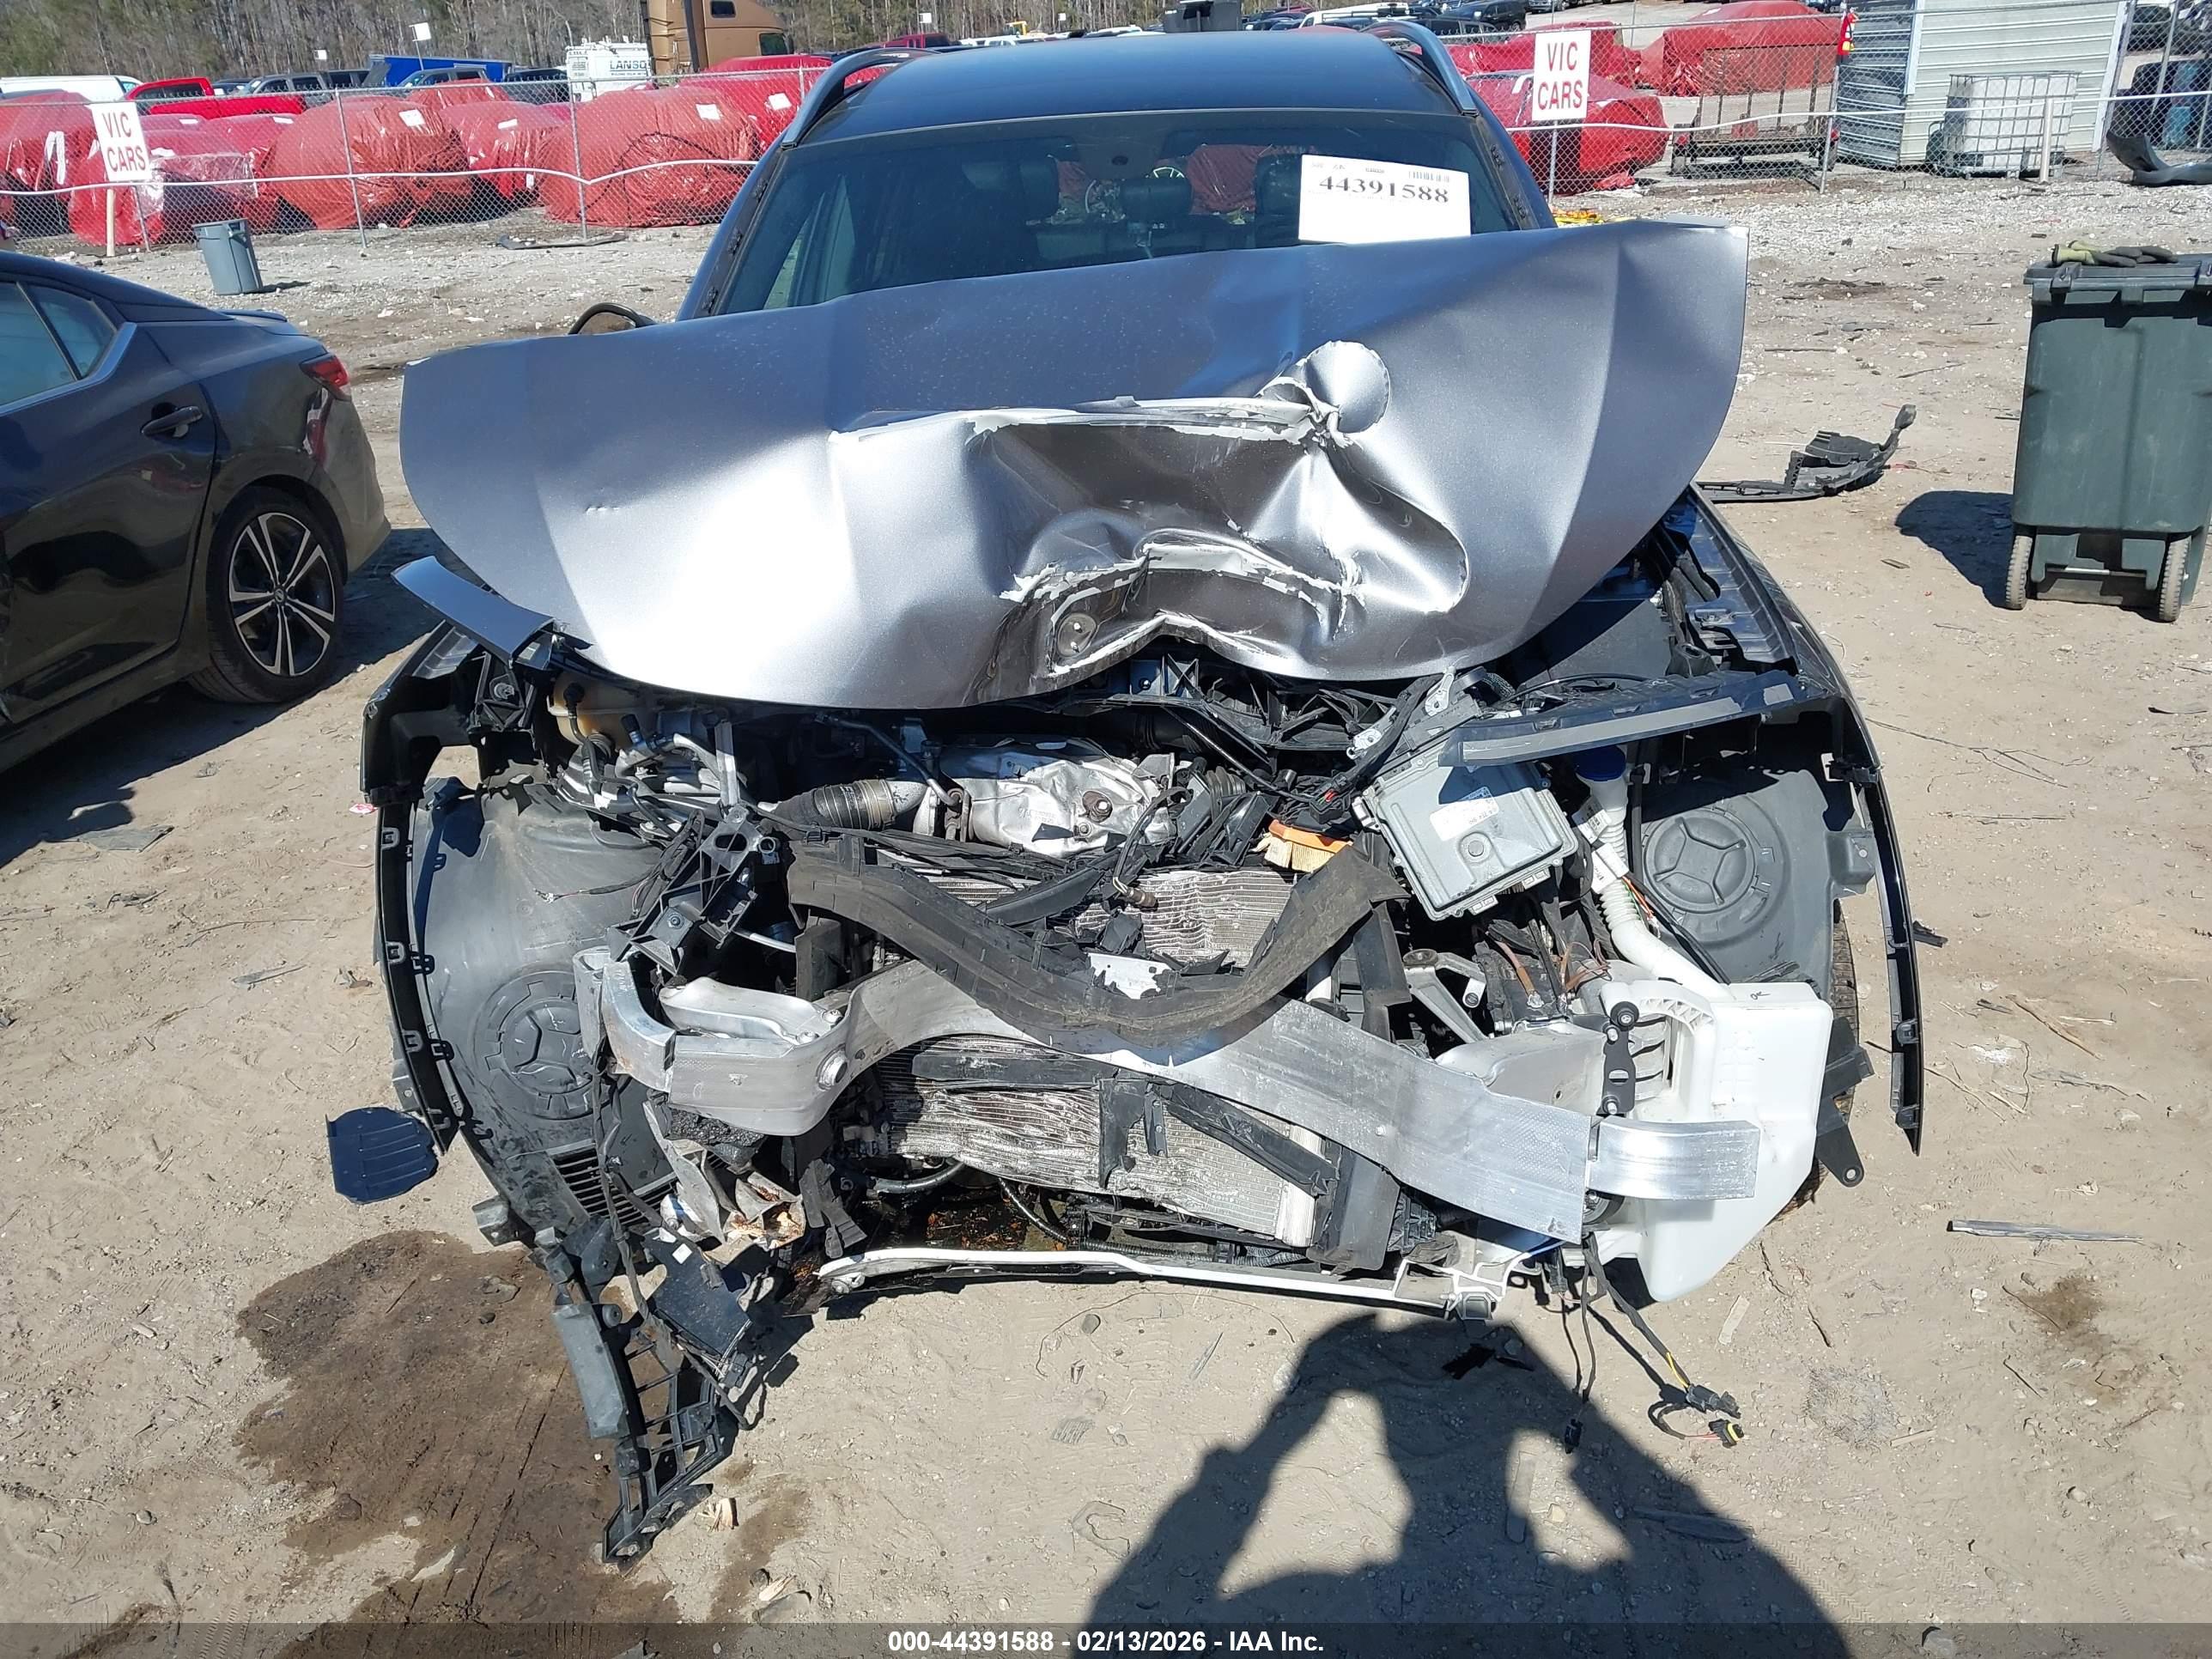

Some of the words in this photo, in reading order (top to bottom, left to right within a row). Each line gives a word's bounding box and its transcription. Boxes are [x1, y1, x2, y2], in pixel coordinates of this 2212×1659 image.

[1547, 41, 1577, 71] VIC
[1538, 80, 1583, 110] CARS
[101, 111, 131, 137] VIC
[106, 145, 146, 172] CARS
[1319, 175, 1449, 204] 44391588
